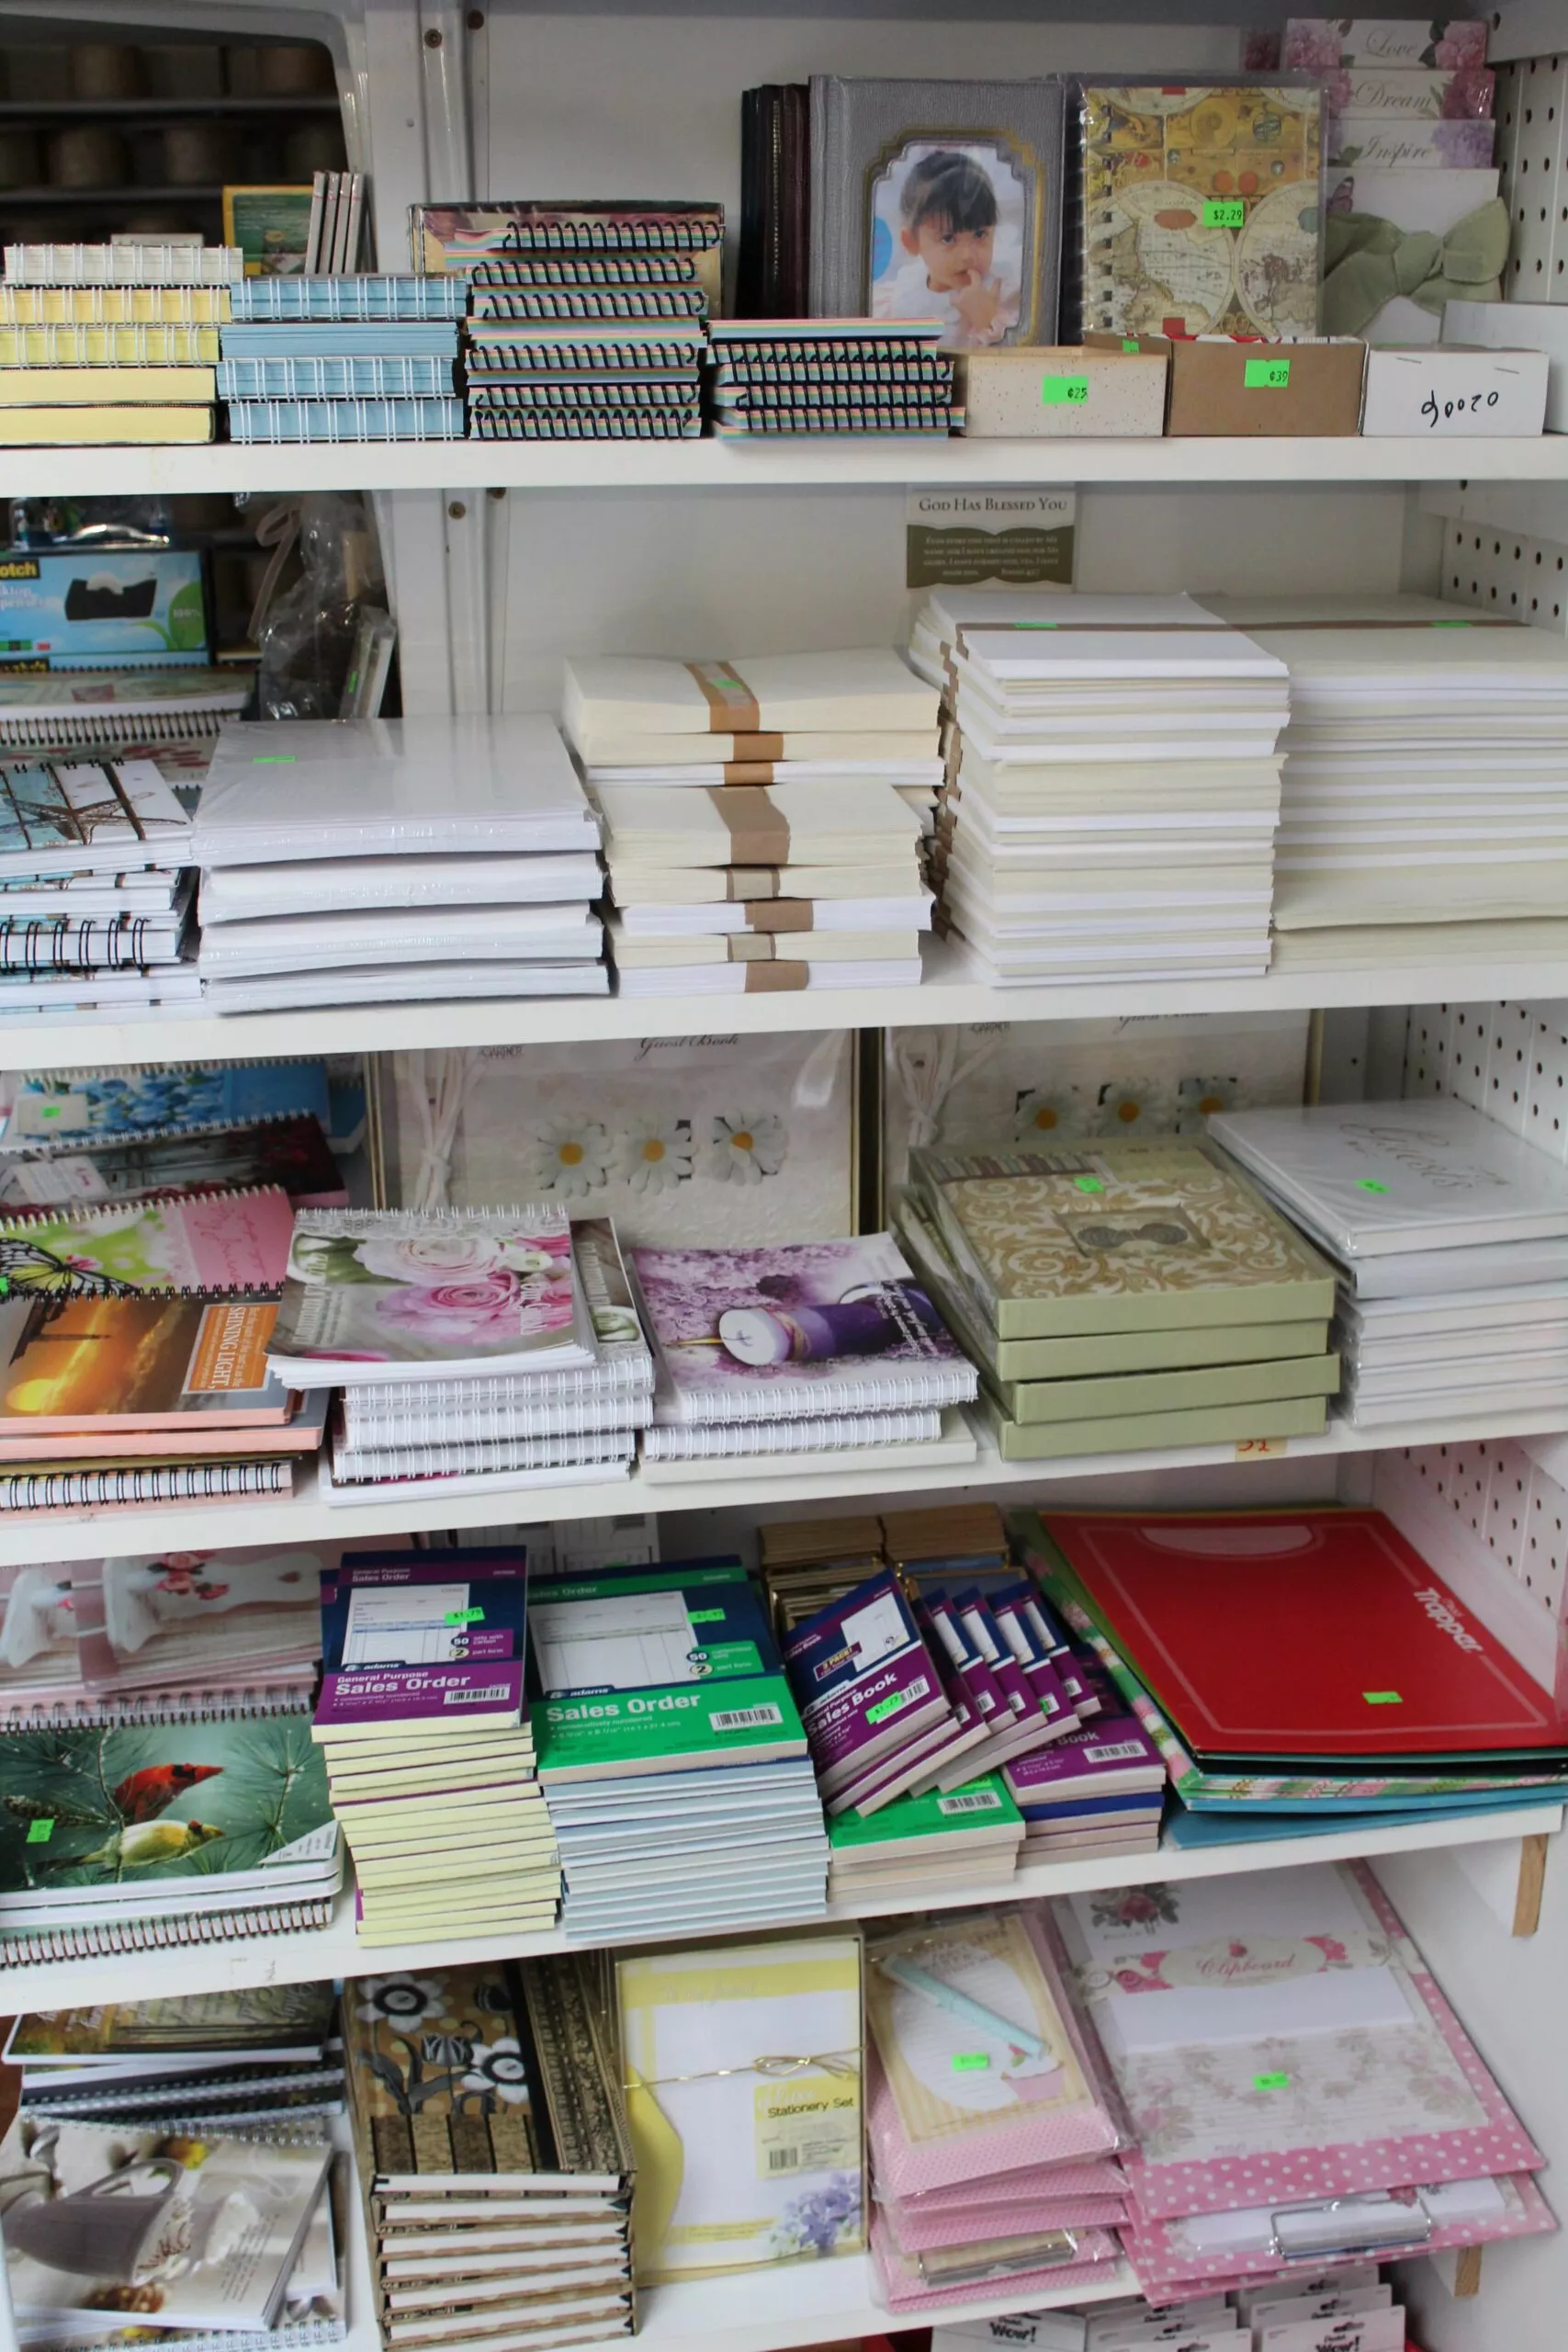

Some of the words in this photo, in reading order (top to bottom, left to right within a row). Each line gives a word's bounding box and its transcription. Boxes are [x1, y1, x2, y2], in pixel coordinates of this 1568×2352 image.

[1363, 28, 1417, 57] Love
[1354, 79, 1432, 108] Dream
[1360, 132, 1432, 167] Inspire
[1213, 209, 1243, 220] $2.29
[0, 561, 37, 577] otch
[220, 1306, 246, 1351] SHINING
[382, 1573, 410, 1581] Order
[454, 1637, 469, 1645] 50
[689, 1653, 707, 1661] 50
[335, 1680, 398, 1695] Sales
[406, 1676, 470, 1690] Order
[338, 1674, 379, 1683] General
[383, 1671, 428, 1681] Purpose
[570, 1688, 609, 1697] adams
[546, 1705, 620, 1723] Sales
[627, 1694, 701, 1714] Order
[807, 1703, 851, 1735] Sales
[852, 1672, 897, 1706] Book
[768, 2101, 829, 2119] Stationery
[833, 2097, 853, 2109] Set
[989, 2321, 1037, 2344] Wow!
